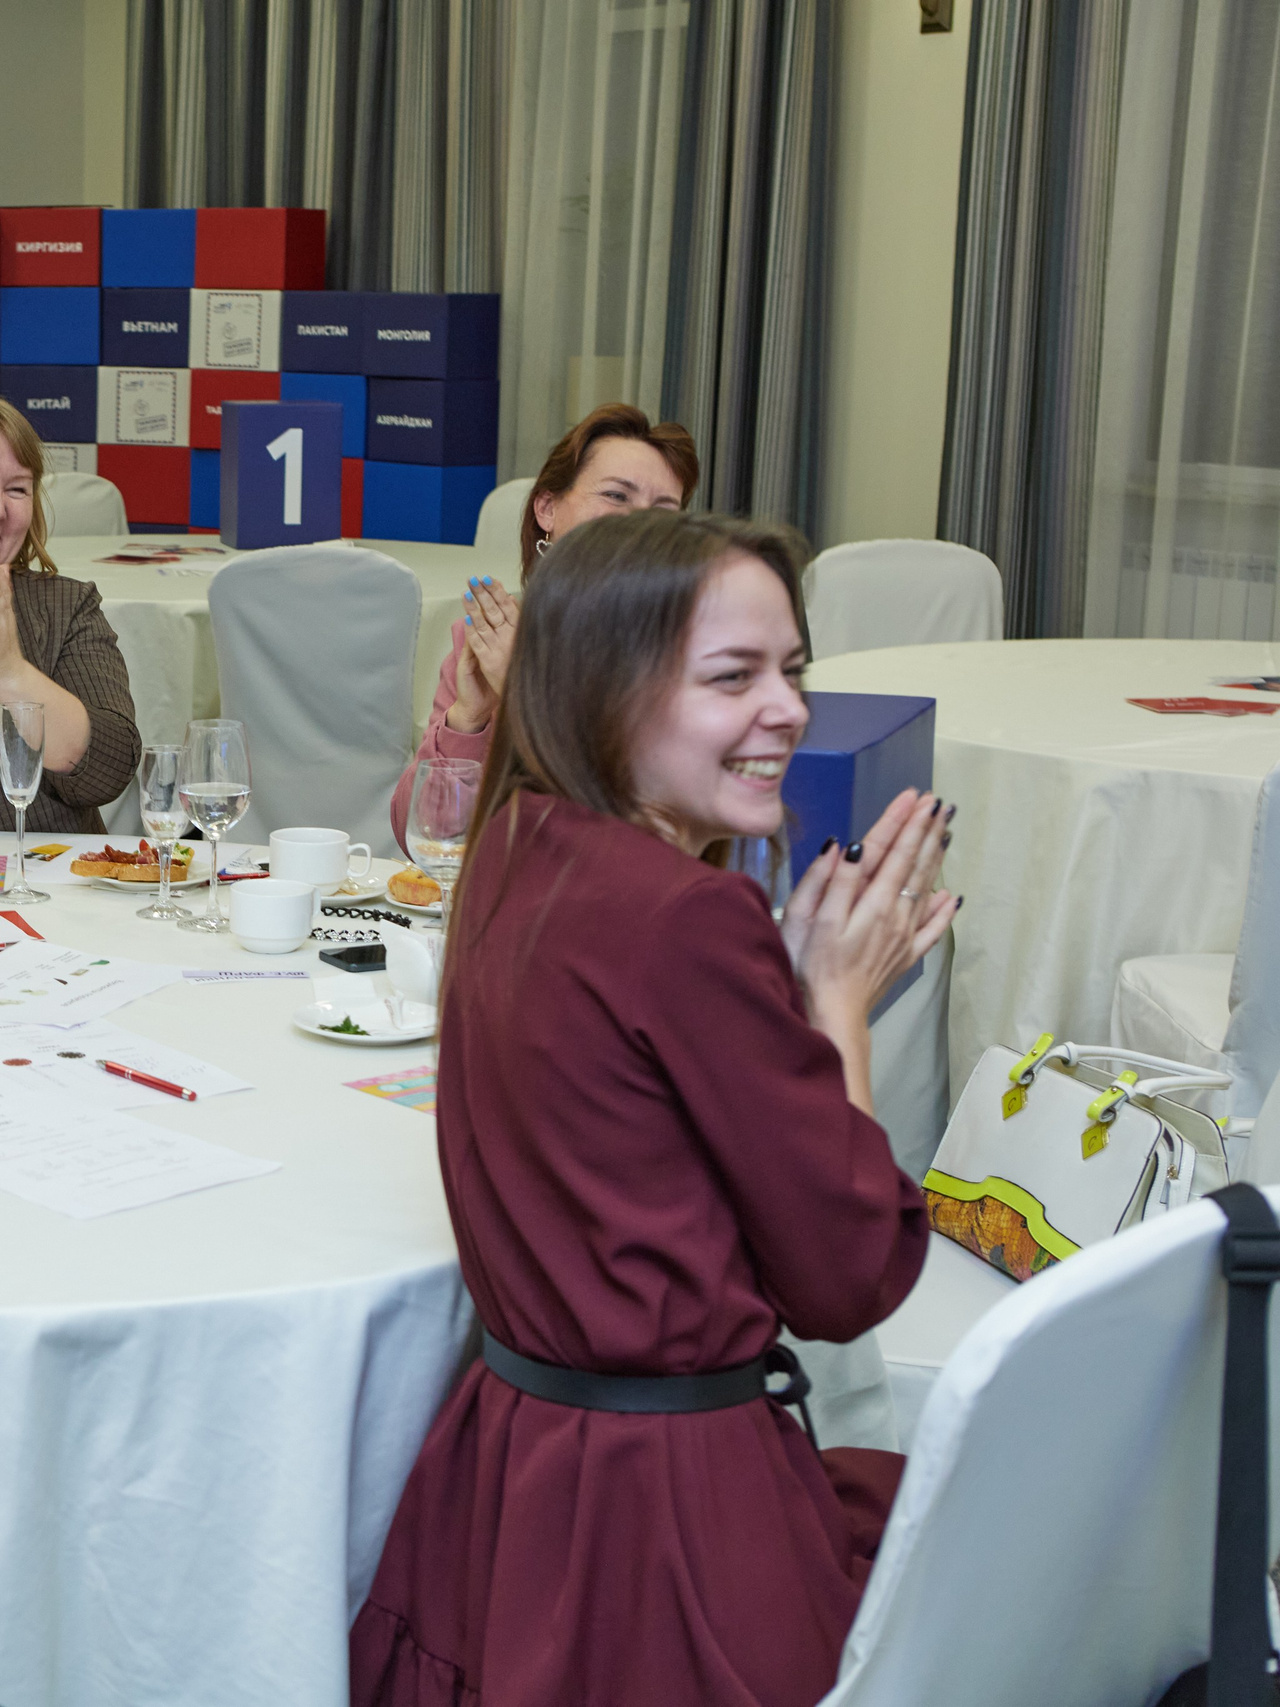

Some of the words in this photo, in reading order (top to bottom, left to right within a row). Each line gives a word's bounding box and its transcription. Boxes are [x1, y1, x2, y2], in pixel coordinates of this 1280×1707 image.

[15, 241, 83, 254] КИРГИЗИЯ
[122, 320, 179, 334] ВЬЕТНАМ
[297, 324, 349, 338] ПАКИСТАН
[377, 328, 431, 342] МОНГОЛИЯ
[27, 396, 71, 410] КИТАЙ
[376, 414, 433, 429] АЗЕРБАЙДЖАН
[265, 427, 304, 525] 1
